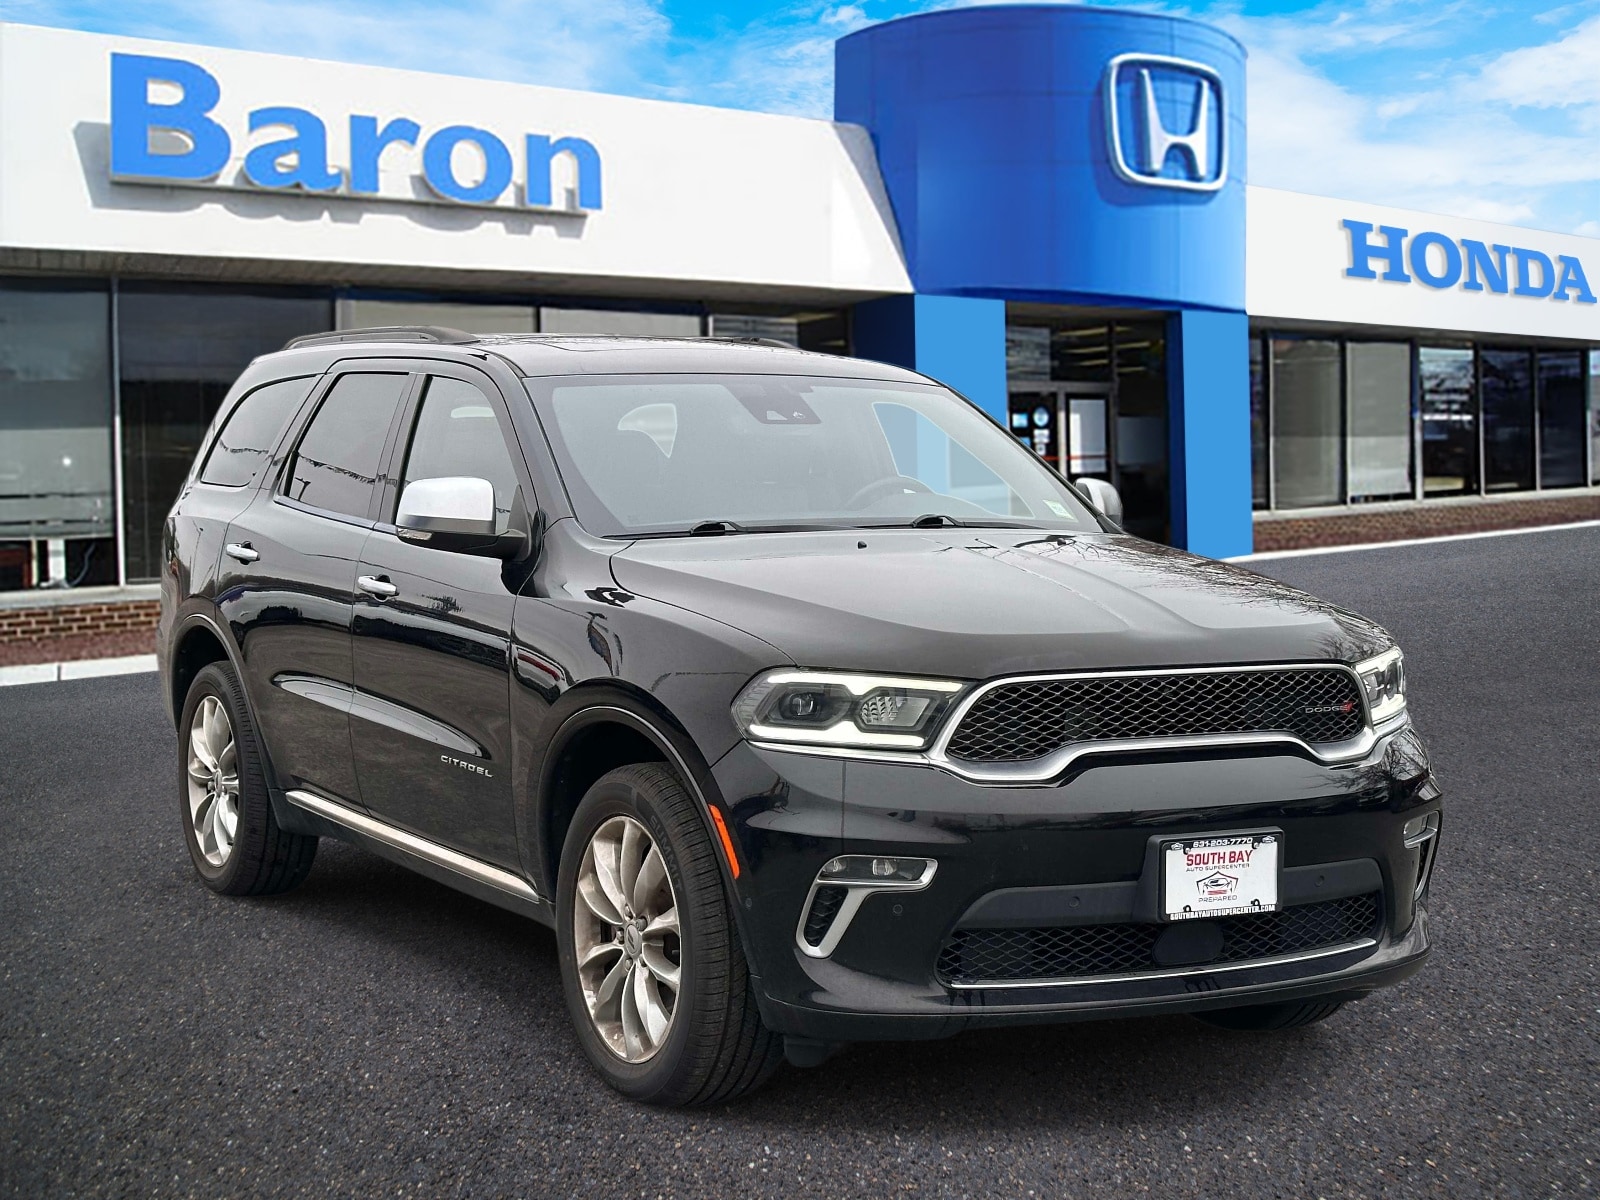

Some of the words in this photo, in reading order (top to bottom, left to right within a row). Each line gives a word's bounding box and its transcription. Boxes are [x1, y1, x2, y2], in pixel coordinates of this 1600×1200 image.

[110, 52, 603, 211] Baron
[1342, 218, 1598, 304] HONDA
[1305, 705, 1347, 714] DODGE
[440, 755, 494, 778] CITADEL
[1192, 837, 1253, 848] 631-203-7770
[1186, 852, 1226, 867] SOUTH
[1228, 849, 1253, 863] BAY
[1204, 863, 1250, 871] SUPERCENTER
